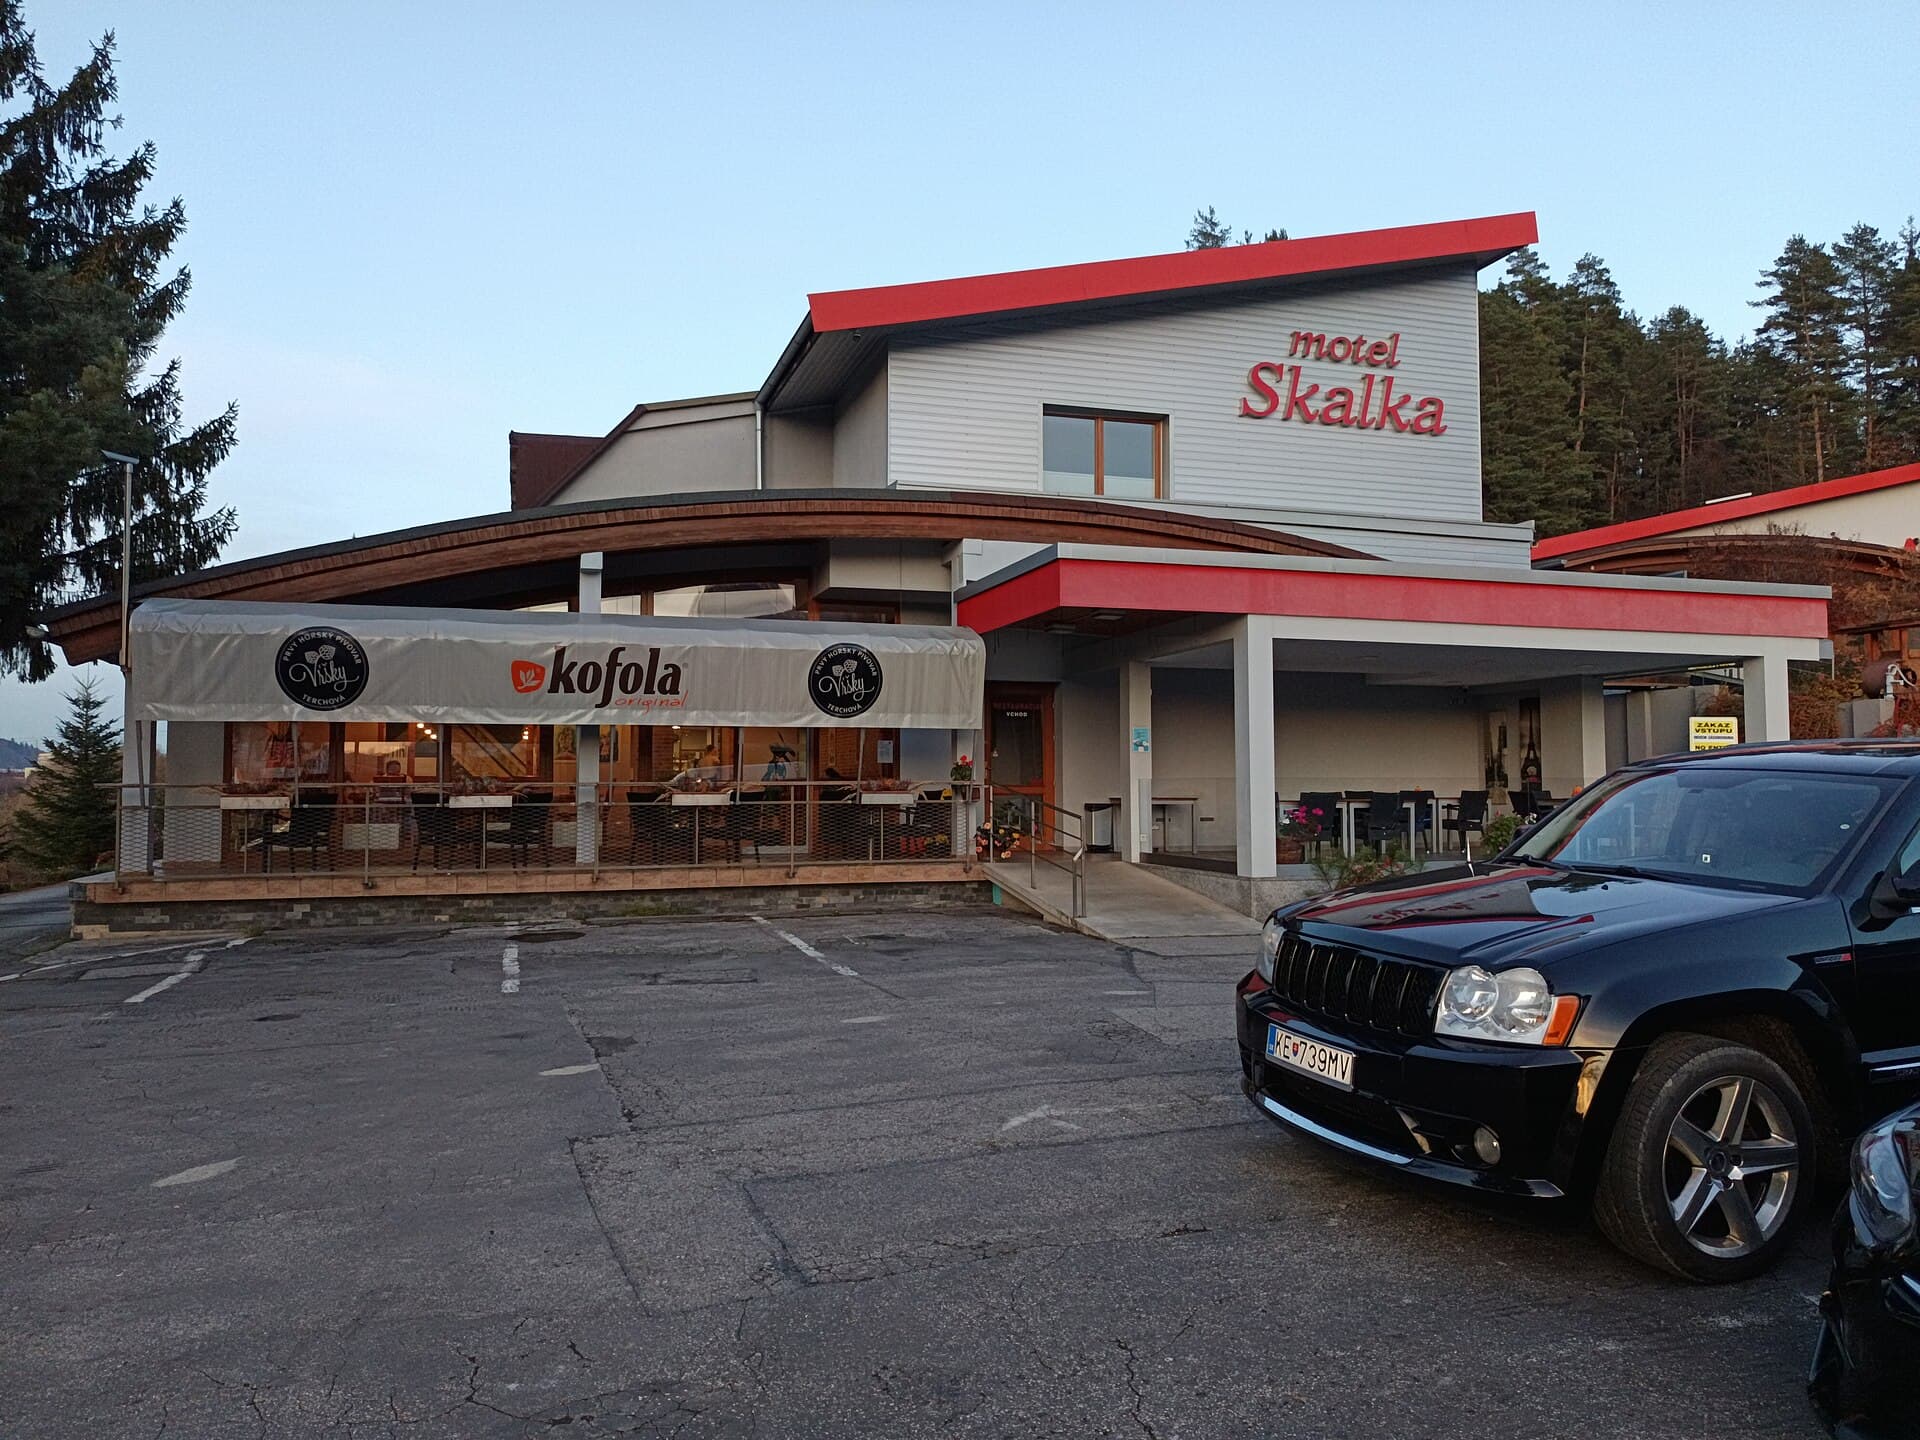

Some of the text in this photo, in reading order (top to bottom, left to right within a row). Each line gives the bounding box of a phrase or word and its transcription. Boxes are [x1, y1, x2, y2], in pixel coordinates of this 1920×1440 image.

[1289, 330, 1400, 368] motel
[1239, 361, 1447, 436] Skalka
[335, 635, 362, 664] PIVOVAR
[547, 645, 682, 708] kofola
[614, 690, 689, 715] original
[1275, 1031, 1350, 1080] KE 739MV
